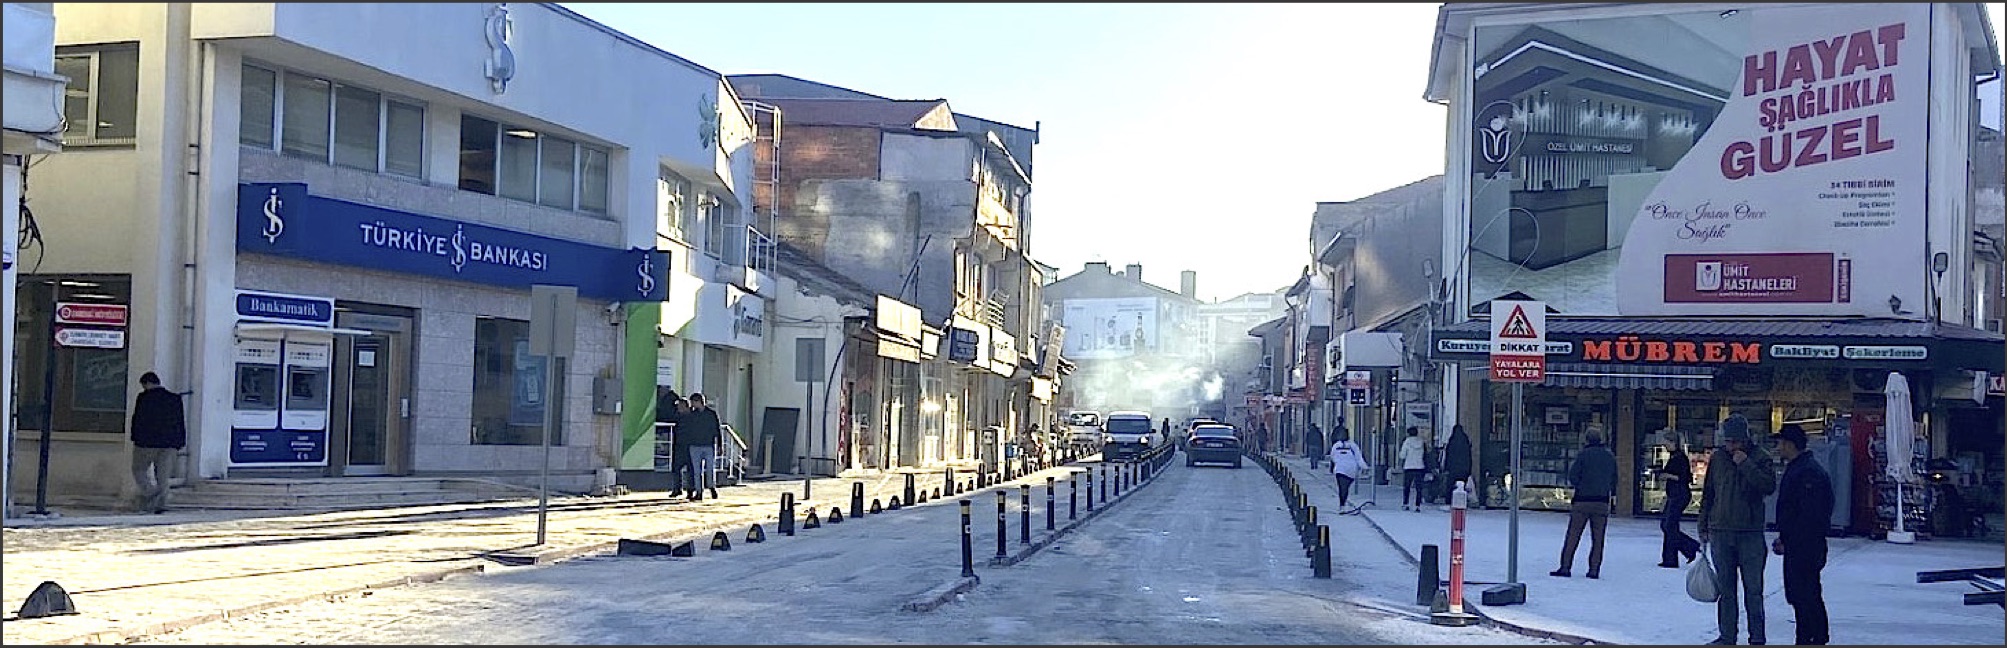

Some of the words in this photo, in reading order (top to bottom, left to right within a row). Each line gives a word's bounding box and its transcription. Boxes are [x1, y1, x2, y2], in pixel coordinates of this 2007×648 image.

[1743, 22, 1906, 96] HAYAT
[1759, 73, 1895, 127] SAĞLIKLA
[1720, 115, 1894, 180] GÜZEL
[359, 220, 448, 255] TÜRKİYE
[470, 242, 548, 271] BANKASI
[1723, 263, 1749, 277] ÜMİT
[1723, 275, 1797, 291] HASTANELERİ
[250, 297, 319, 317] Bankamatik
[1441, 340, 1491, 350] Kuruye
[1500, 342, 1540, 352] DİKKAT
[1582, 336, 1762, 363] MÜBREM
[1774, 346, 1837, 357] Bakliyat
[1494, 360, 1541, 368] YAYALARA
[1495, 369, 1517, 378] YOL
[1519, 369, 1540, 378] VER
